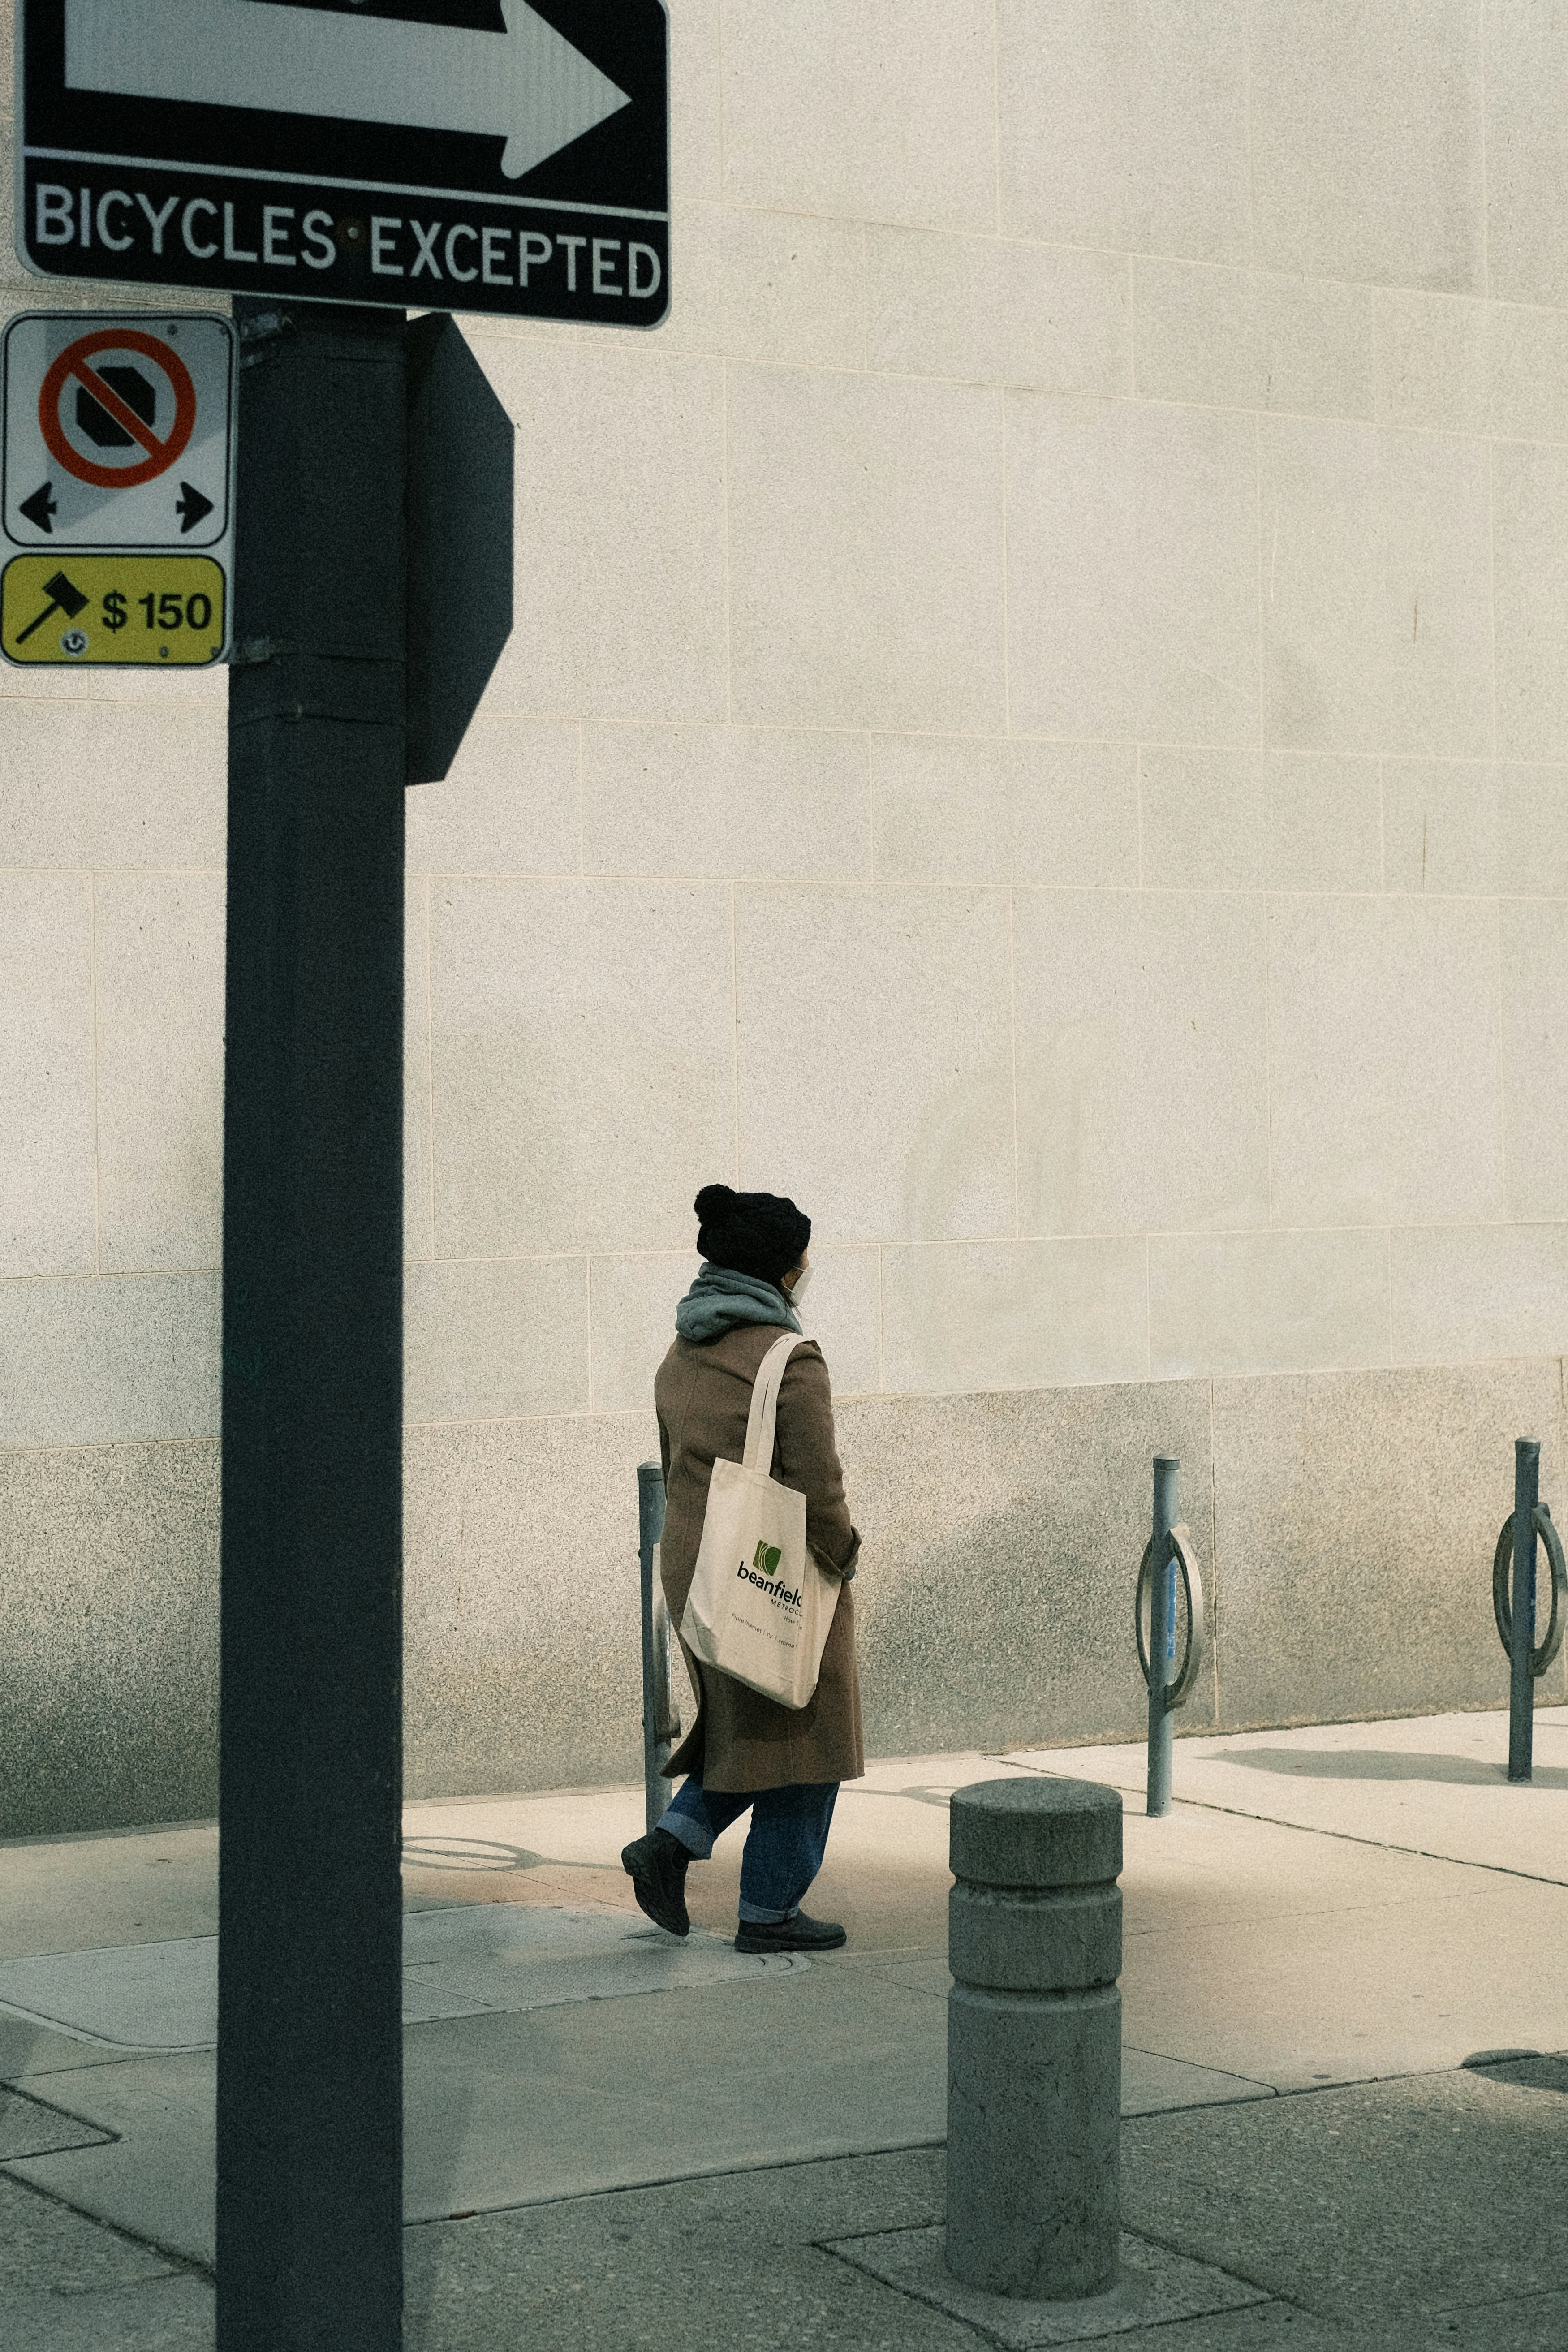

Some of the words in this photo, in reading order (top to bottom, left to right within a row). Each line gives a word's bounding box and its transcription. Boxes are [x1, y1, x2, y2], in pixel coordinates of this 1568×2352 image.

[36, 183, 336, 269] BICYCLES
[370, 216, 662, 298] EXCEPTED
[731, 1613, 744, 1623] Fibre
[745, 1620, 762, 1634] Internet
[778, 1638, 795, 1649] Home
[784, 1615, 795, 1624] How
